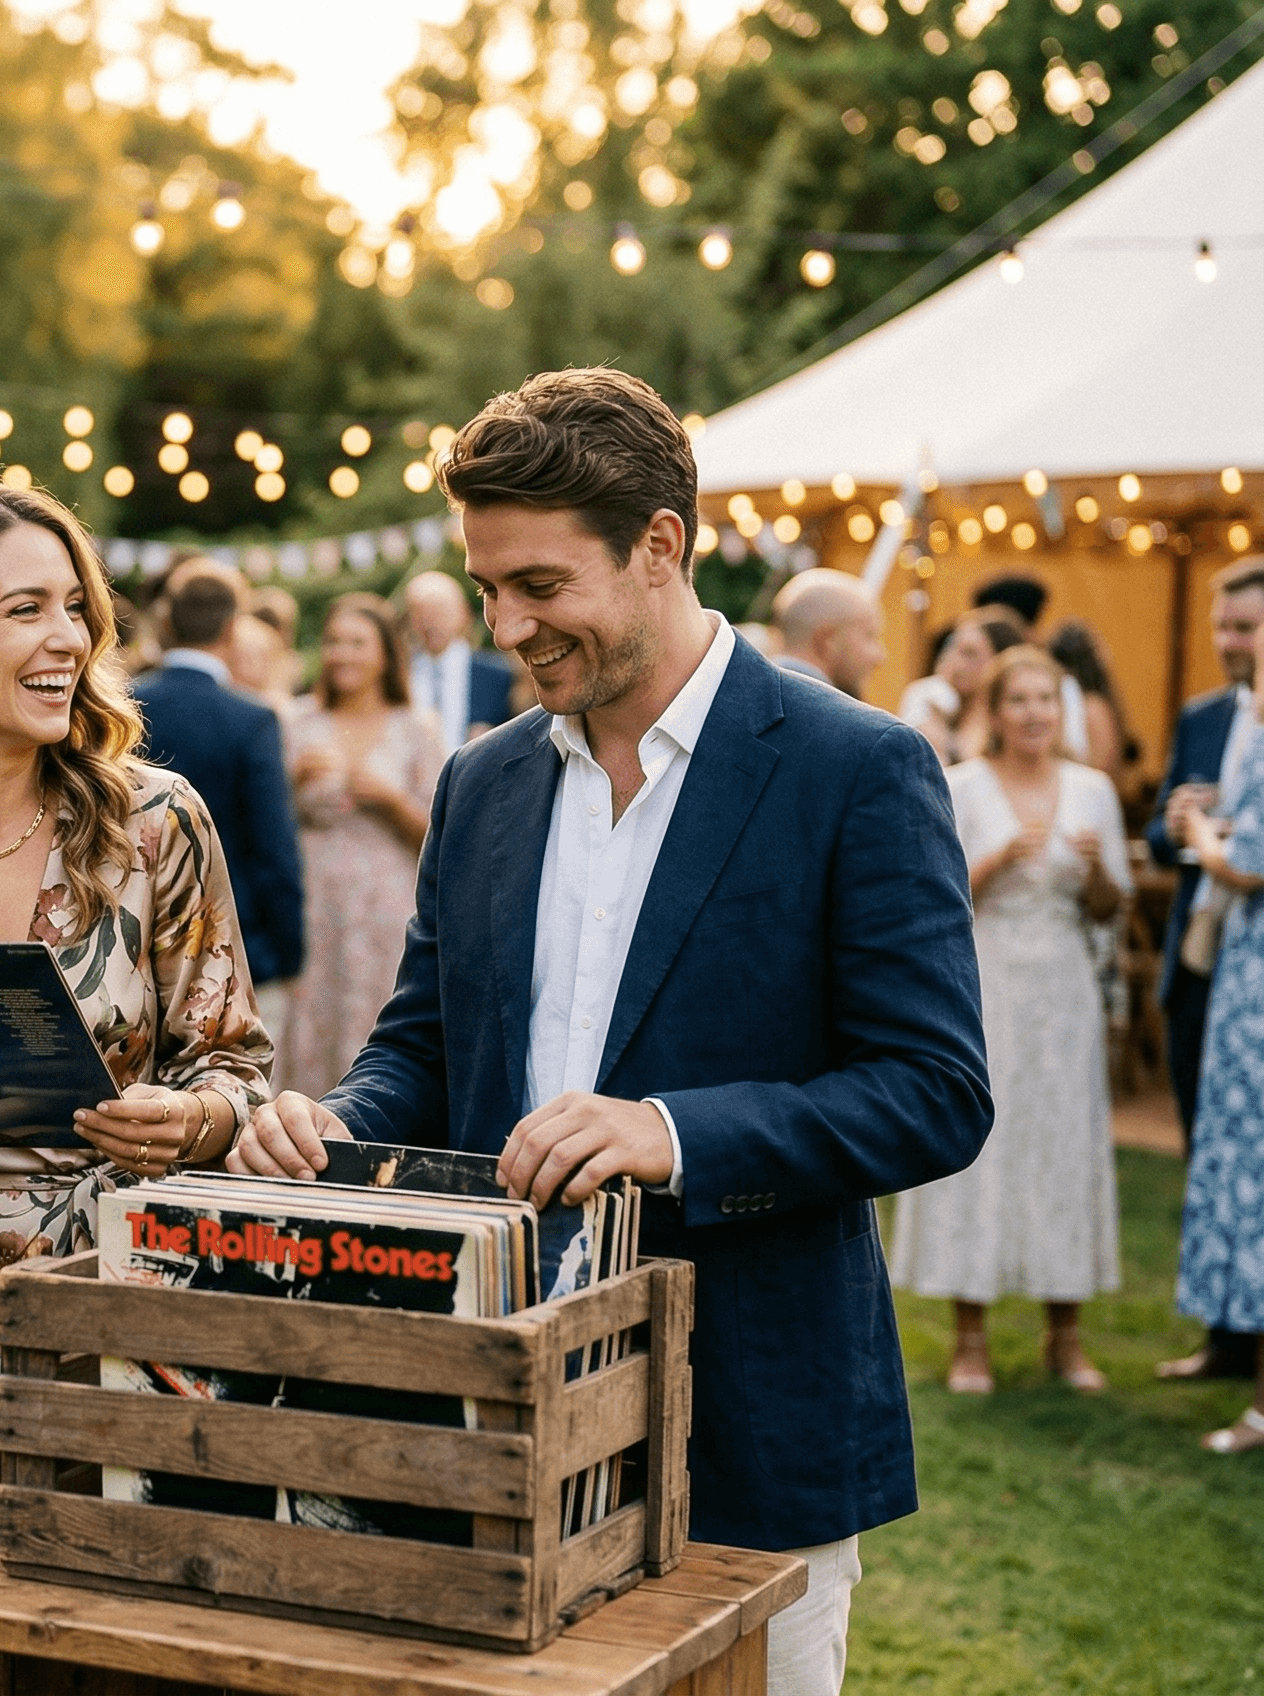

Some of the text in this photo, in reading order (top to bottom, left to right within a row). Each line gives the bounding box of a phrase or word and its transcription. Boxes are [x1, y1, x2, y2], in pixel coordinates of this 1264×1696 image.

[126, 1212, 454, 1282] The Rolling Stones
